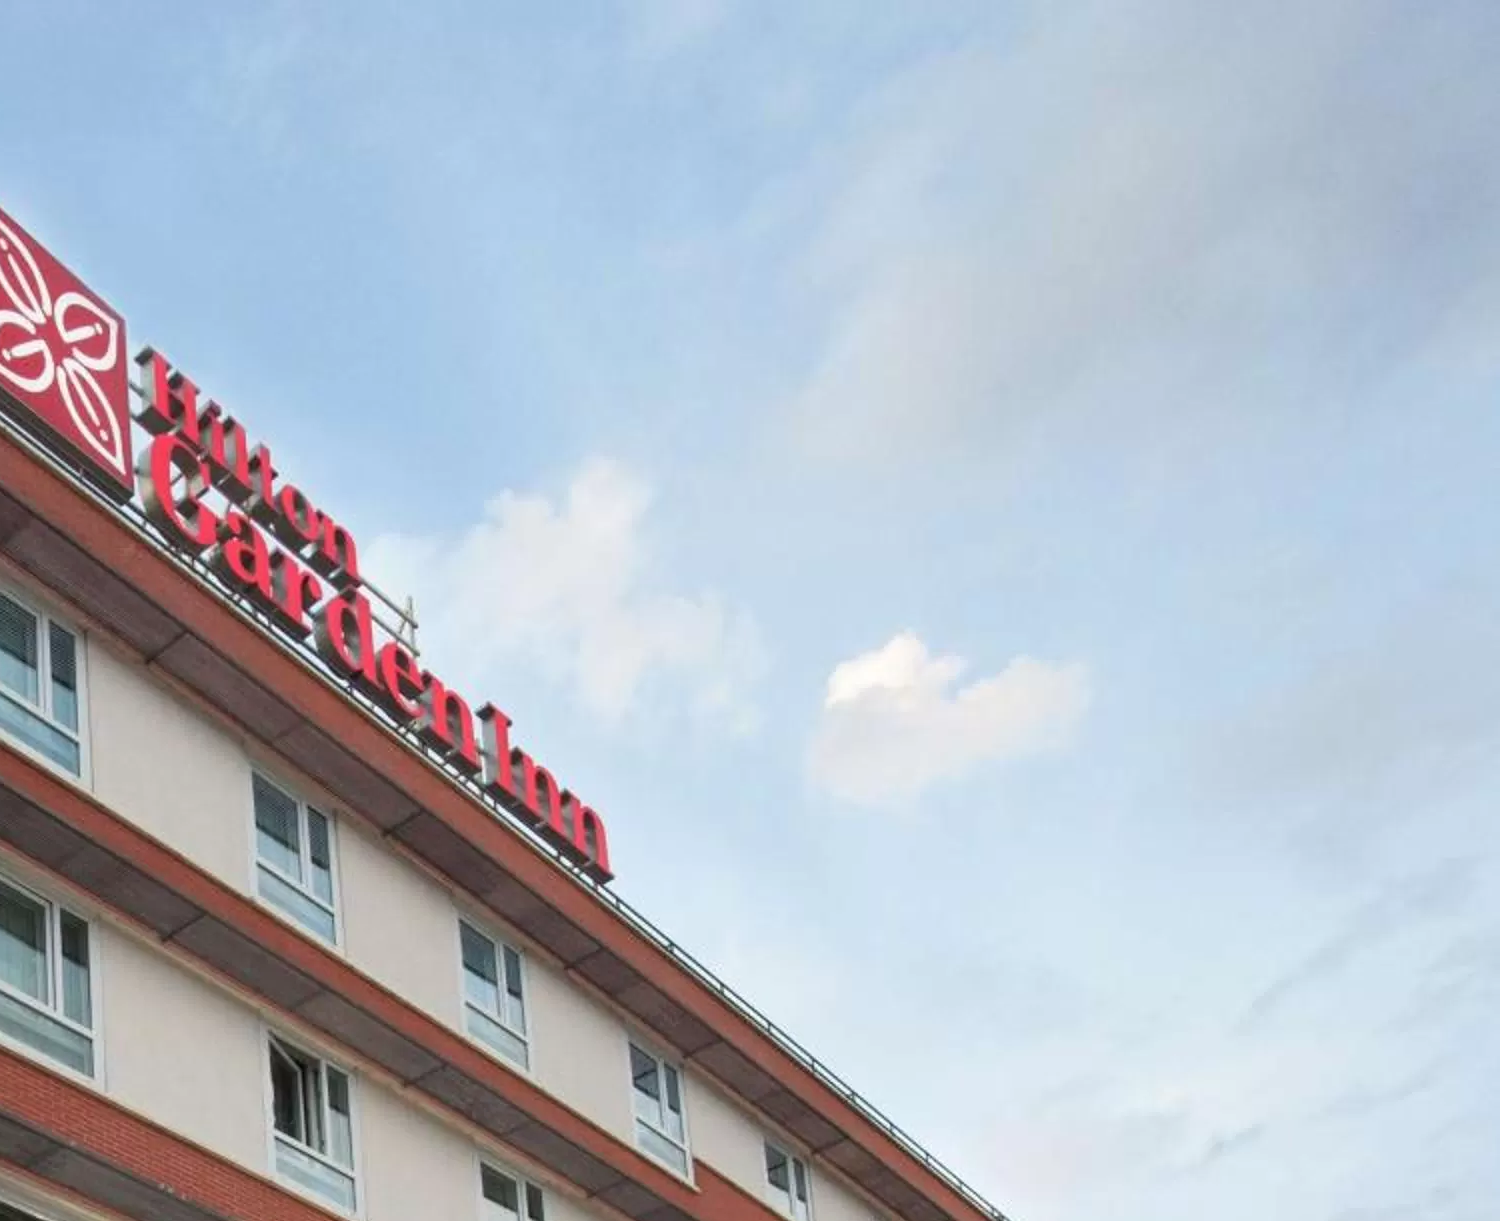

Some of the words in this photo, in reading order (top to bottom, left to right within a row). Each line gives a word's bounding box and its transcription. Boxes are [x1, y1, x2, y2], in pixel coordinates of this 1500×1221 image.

[135, 345, 361, 592] Hilton
[138, 433, 482, 776] Garden
[477, 701, 614, 884] Inn
